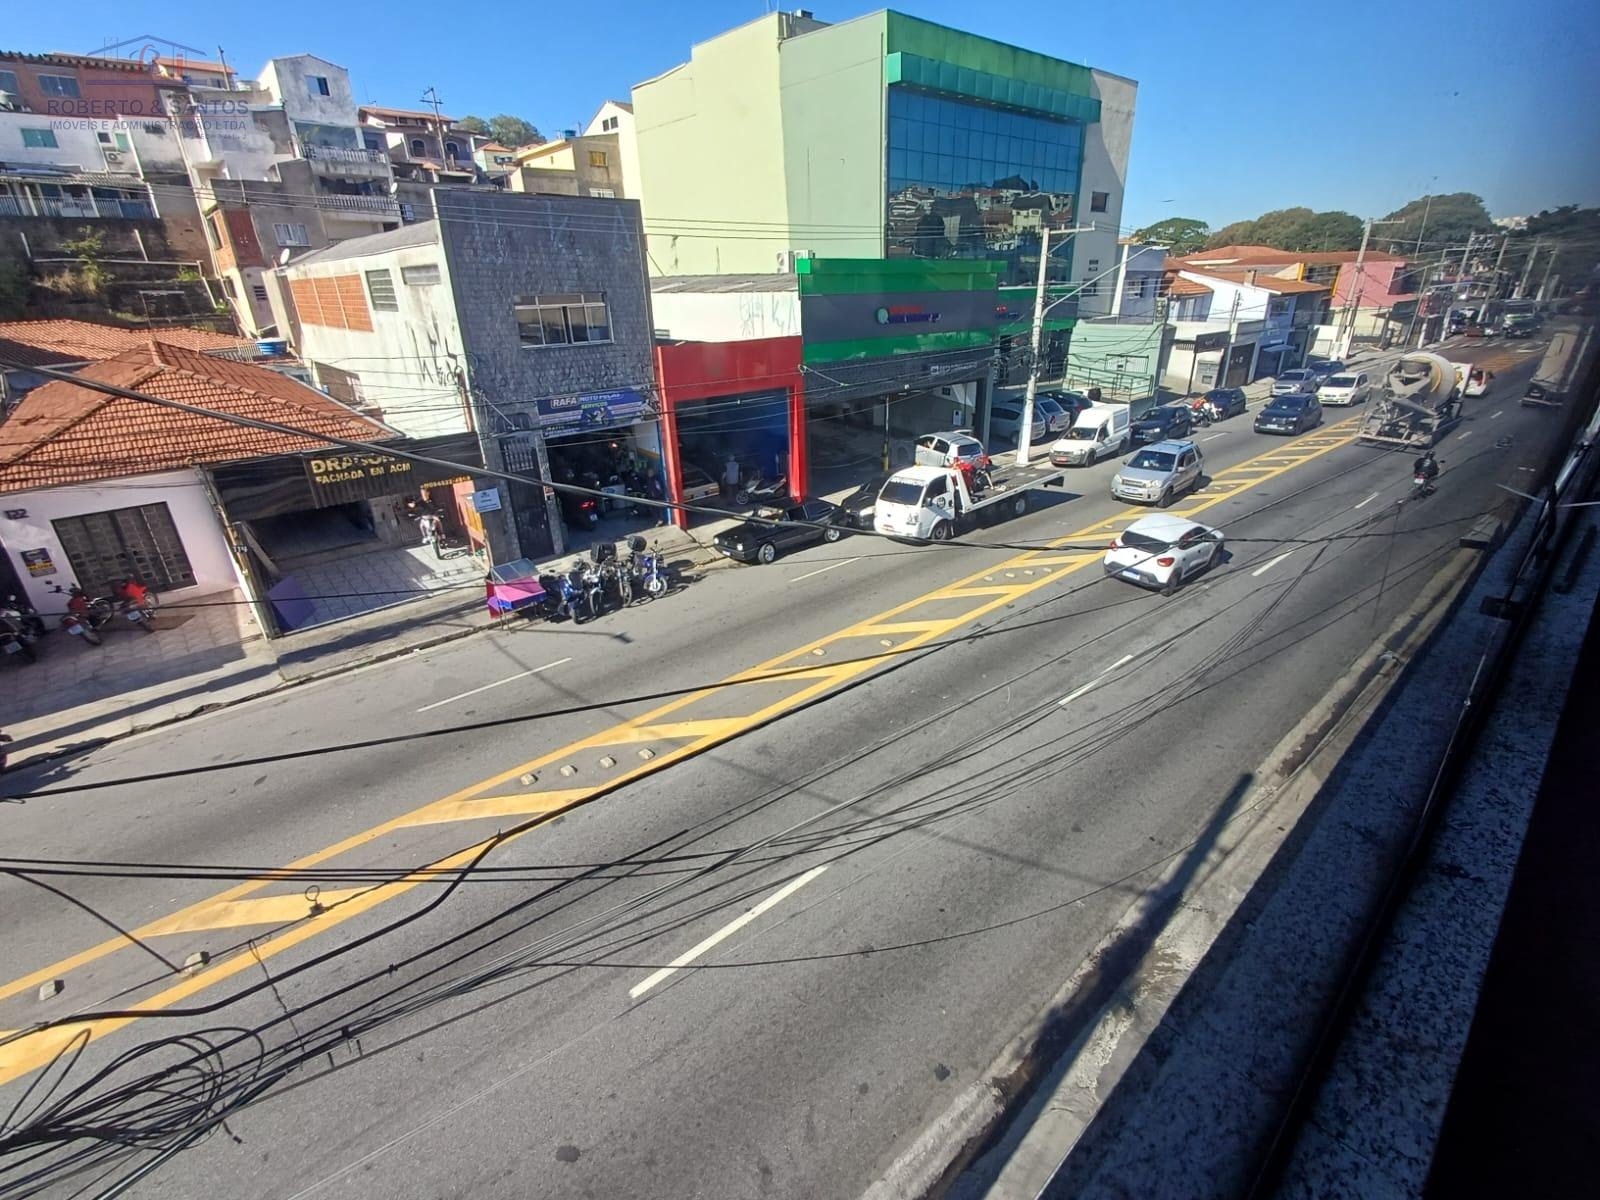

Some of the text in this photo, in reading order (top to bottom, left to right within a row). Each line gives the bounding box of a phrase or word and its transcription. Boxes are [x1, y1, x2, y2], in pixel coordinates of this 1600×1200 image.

[553, 396, 577, 407] RAFA
[316, 462, 411, 484] FACHADA EM ACM
